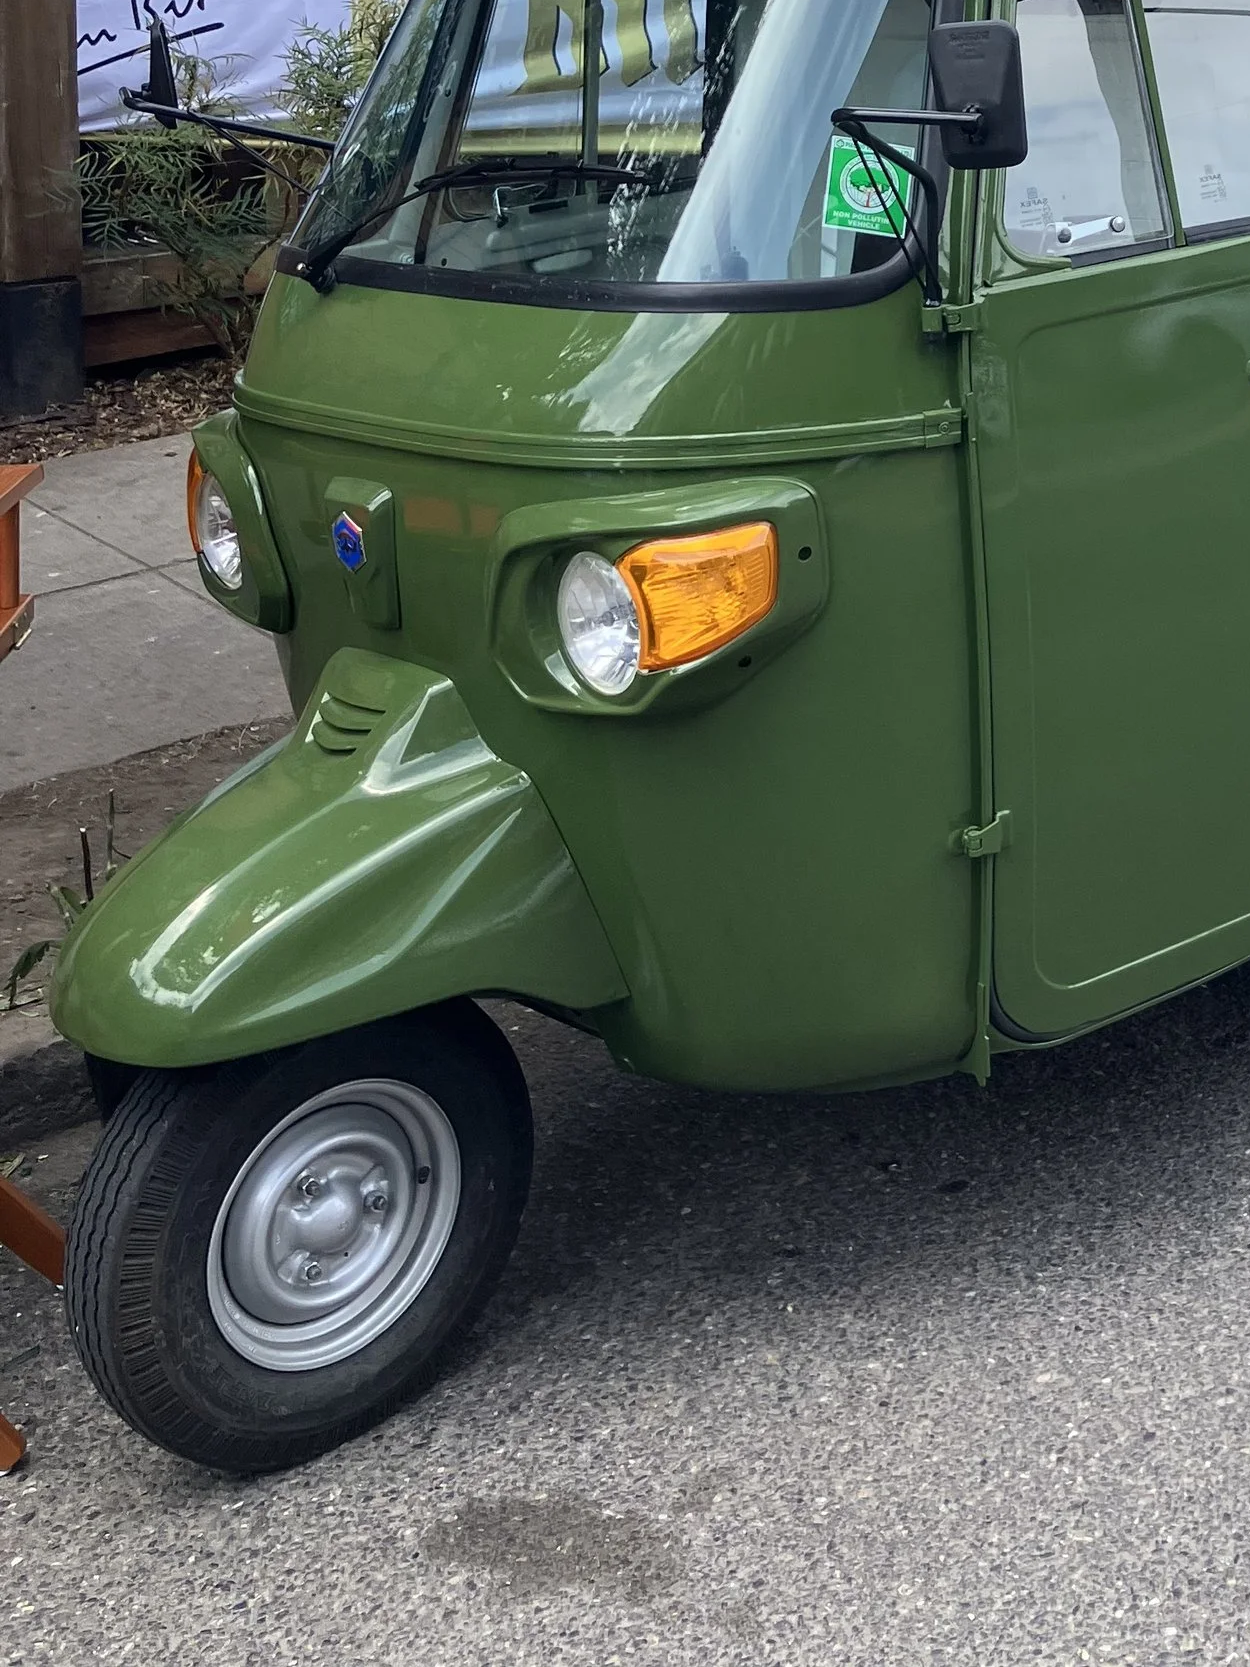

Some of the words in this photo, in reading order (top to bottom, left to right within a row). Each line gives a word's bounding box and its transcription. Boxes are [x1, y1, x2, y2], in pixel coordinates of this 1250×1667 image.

[833, 210, 850, 219] NON
[852, 212, 891, 225] POLLUTIN
[848, 219, 880, 230] VEHICLE
